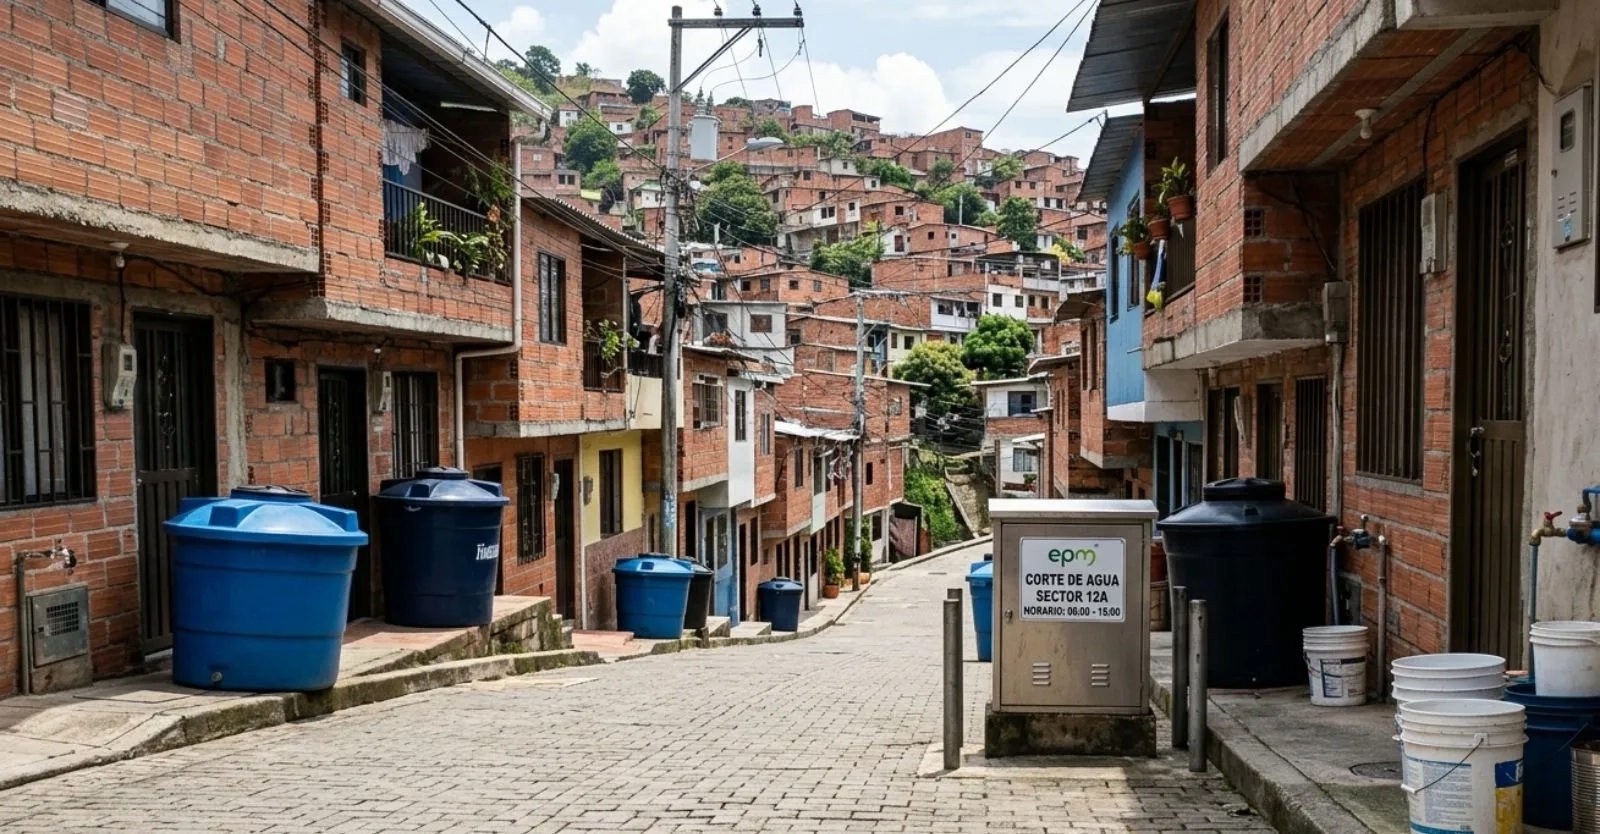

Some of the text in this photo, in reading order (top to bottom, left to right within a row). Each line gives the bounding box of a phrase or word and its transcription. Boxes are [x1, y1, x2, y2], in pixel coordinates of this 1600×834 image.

[1048, 549, 1096, 567] epm
[1025, 573, 1120, 586] CORTE DE AGUA
[1036, 590, 1109, 603] SECTOR 12A
